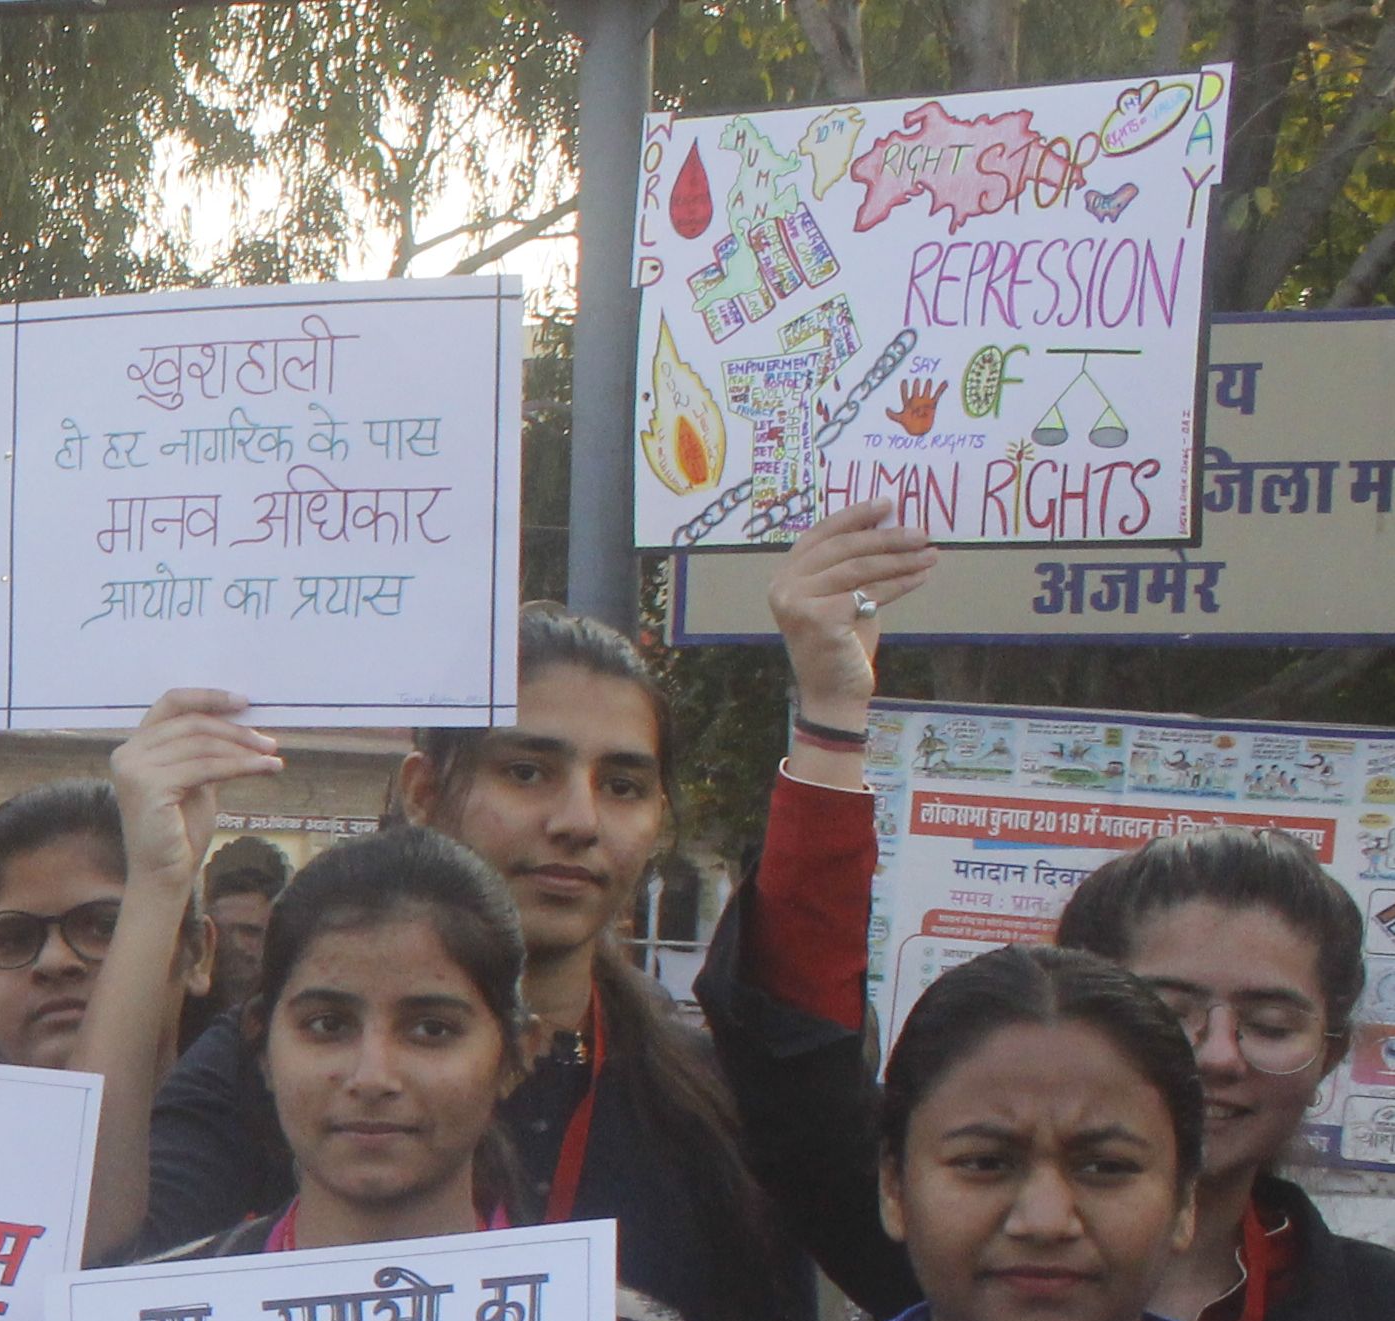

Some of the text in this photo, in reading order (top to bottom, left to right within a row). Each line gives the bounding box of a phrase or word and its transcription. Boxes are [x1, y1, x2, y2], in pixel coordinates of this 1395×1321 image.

[879, 142, 975, 186] RIGHT
[975, 131, 1101, 215] STOP
[903, 238, 1185, 329] REPRESSION
[127, 314, 359, 410] खुशहाली
[910, 356, 941, 374] SAY
[56, 403, 442, 470] हो हर नागरिक के पास
[863, 434, 987, 454] TO YOUR RIGHTS
[96, 464, 453, 554] मानव अधिकार
[980, 455, 1161, 538] RIGHTS
[1202, 446, 1340, 514] जिला
[81, 563, 415, 630] आयोग का प्रयास
[1032, 549, 1226, 614] अजमेर
[921, 798, 987, 828] लोकसभा
[988, 808, 1031, 835] चुनाव
[1034, 811, 1080, 836] 2019
[1100, 815, 1153, 839] मतदान
[953, 860, 1027, 884] मतदान
